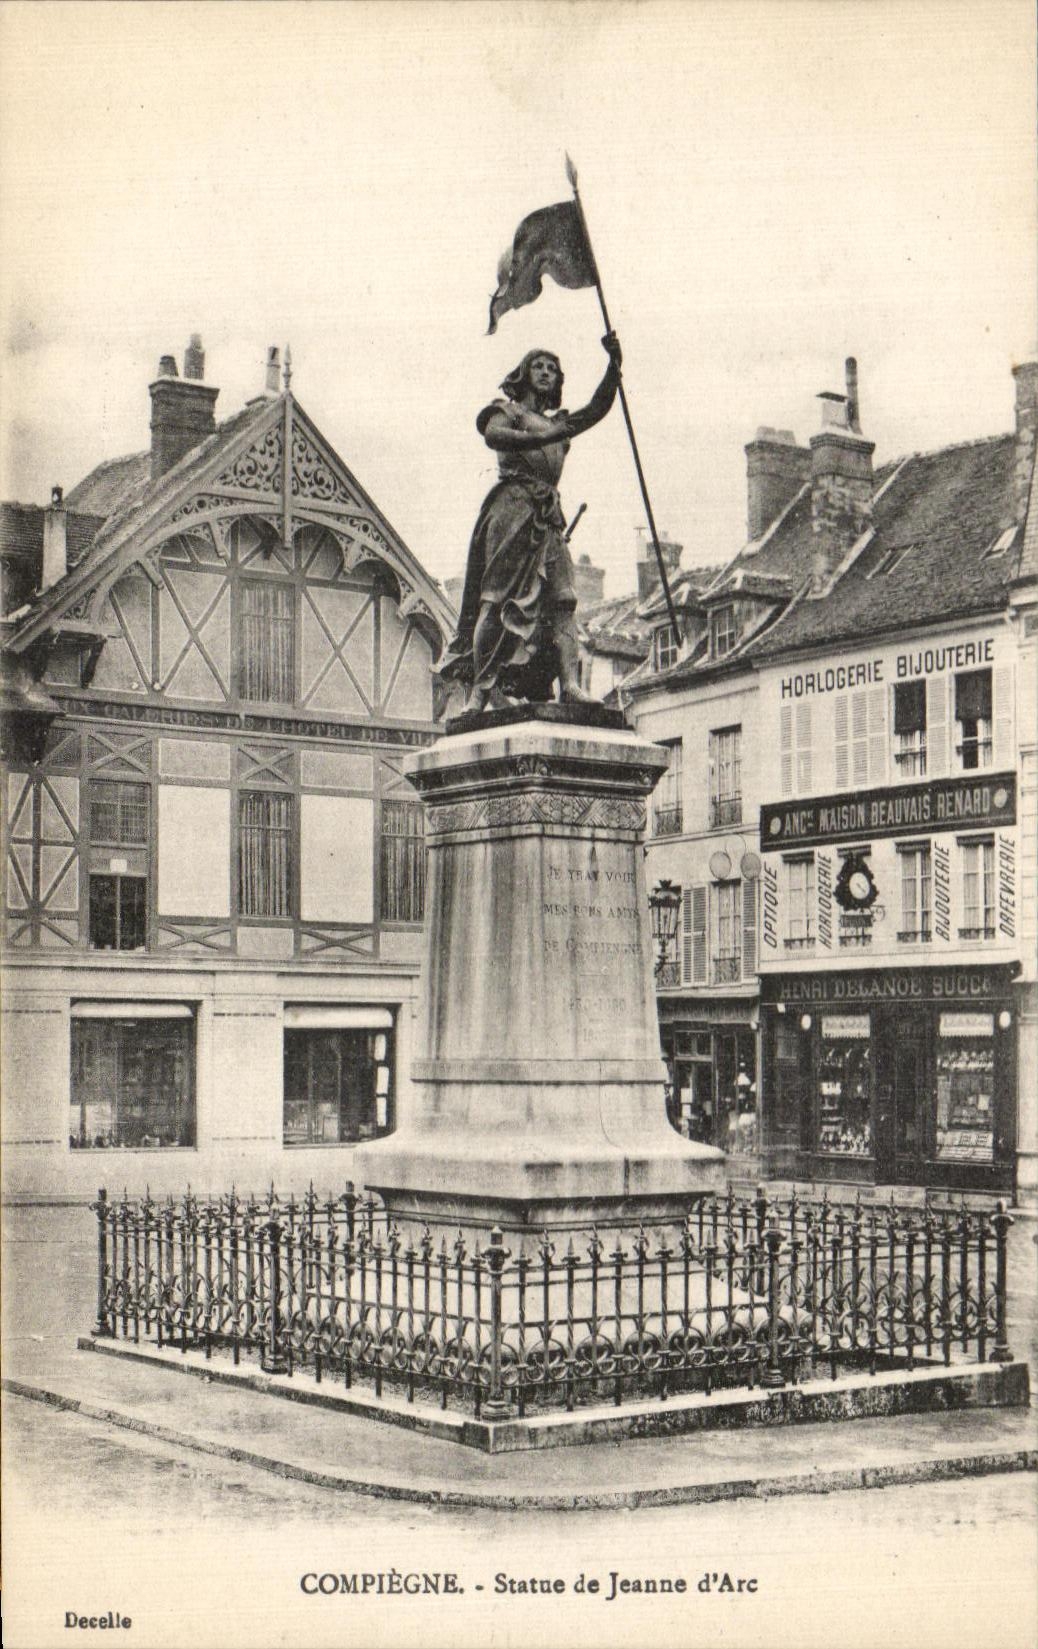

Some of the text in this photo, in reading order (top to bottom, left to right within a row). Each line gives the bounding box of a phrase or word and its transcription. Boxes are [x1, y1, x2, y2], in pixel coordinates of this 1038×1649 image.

[781, 639, 995, 699] HORLOGERIE BIJOUTERIE
[819, 798, 866, 833] MAISON
[871, 794, 931, 826] BEAUVAIS
[937, 787, 991, 816] RENARD
[543, 904, 568, 915] MES
[763, 862, 779, 949] OPTIQUE
[818, 851, 833, 950] HORLOGERIE
[935, 841, 951, 942] BIJOUTERIE
[999, 834, 1016, 938] ORFEVRERIE
[780, 982, 828, 999] HENRI
